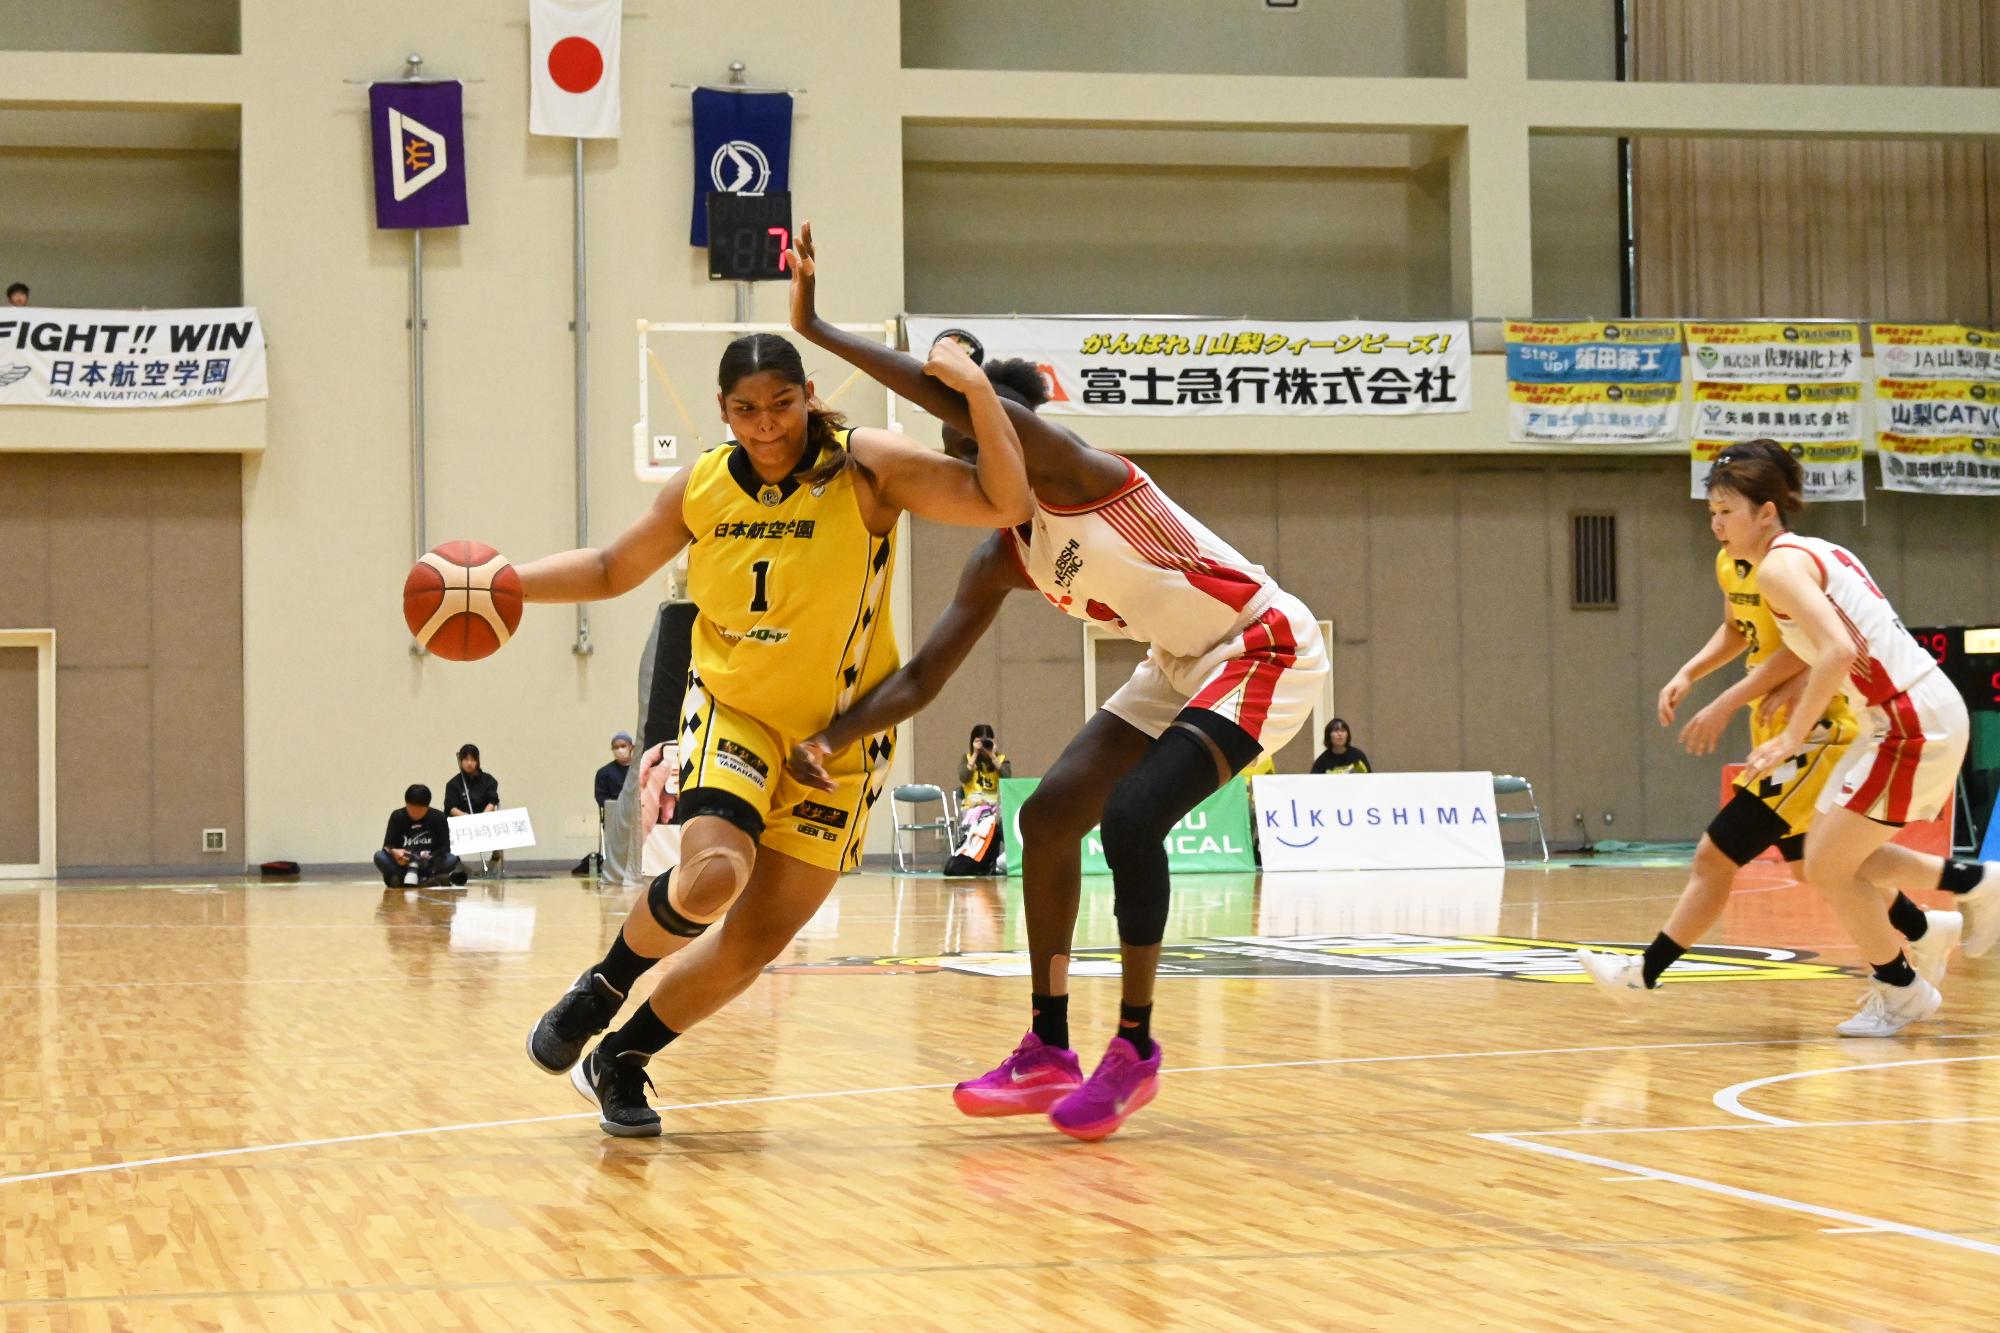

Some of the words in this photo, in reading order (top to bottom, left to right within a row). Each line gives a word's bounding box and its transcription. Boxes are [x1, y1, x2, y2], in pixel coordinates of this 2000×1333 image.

[768, 227, 788, 272] 7
[0, 321, 157, 354] FIGHT!!
[170, 321, 253, 353] WIN
[1520, 346, 1559, 359] Step
[1543, 359, 1569, 372] up!
[50, 358, 231, 387] 日本航空学園
[1080, 365, 1457, 405] 富士急行株式会社
[46, 388, 92, 398] JAPAN
[93, 388, 161, 401] AVIATION
[161, 386, 226, 399] ACADEMY
[658, 439, 672, 448] W
[750, 560, 770, 612] 1
[1266, 800, 1487, 828] KIKUSHIMA
[1087, 832, 1244, 856] MICAL
